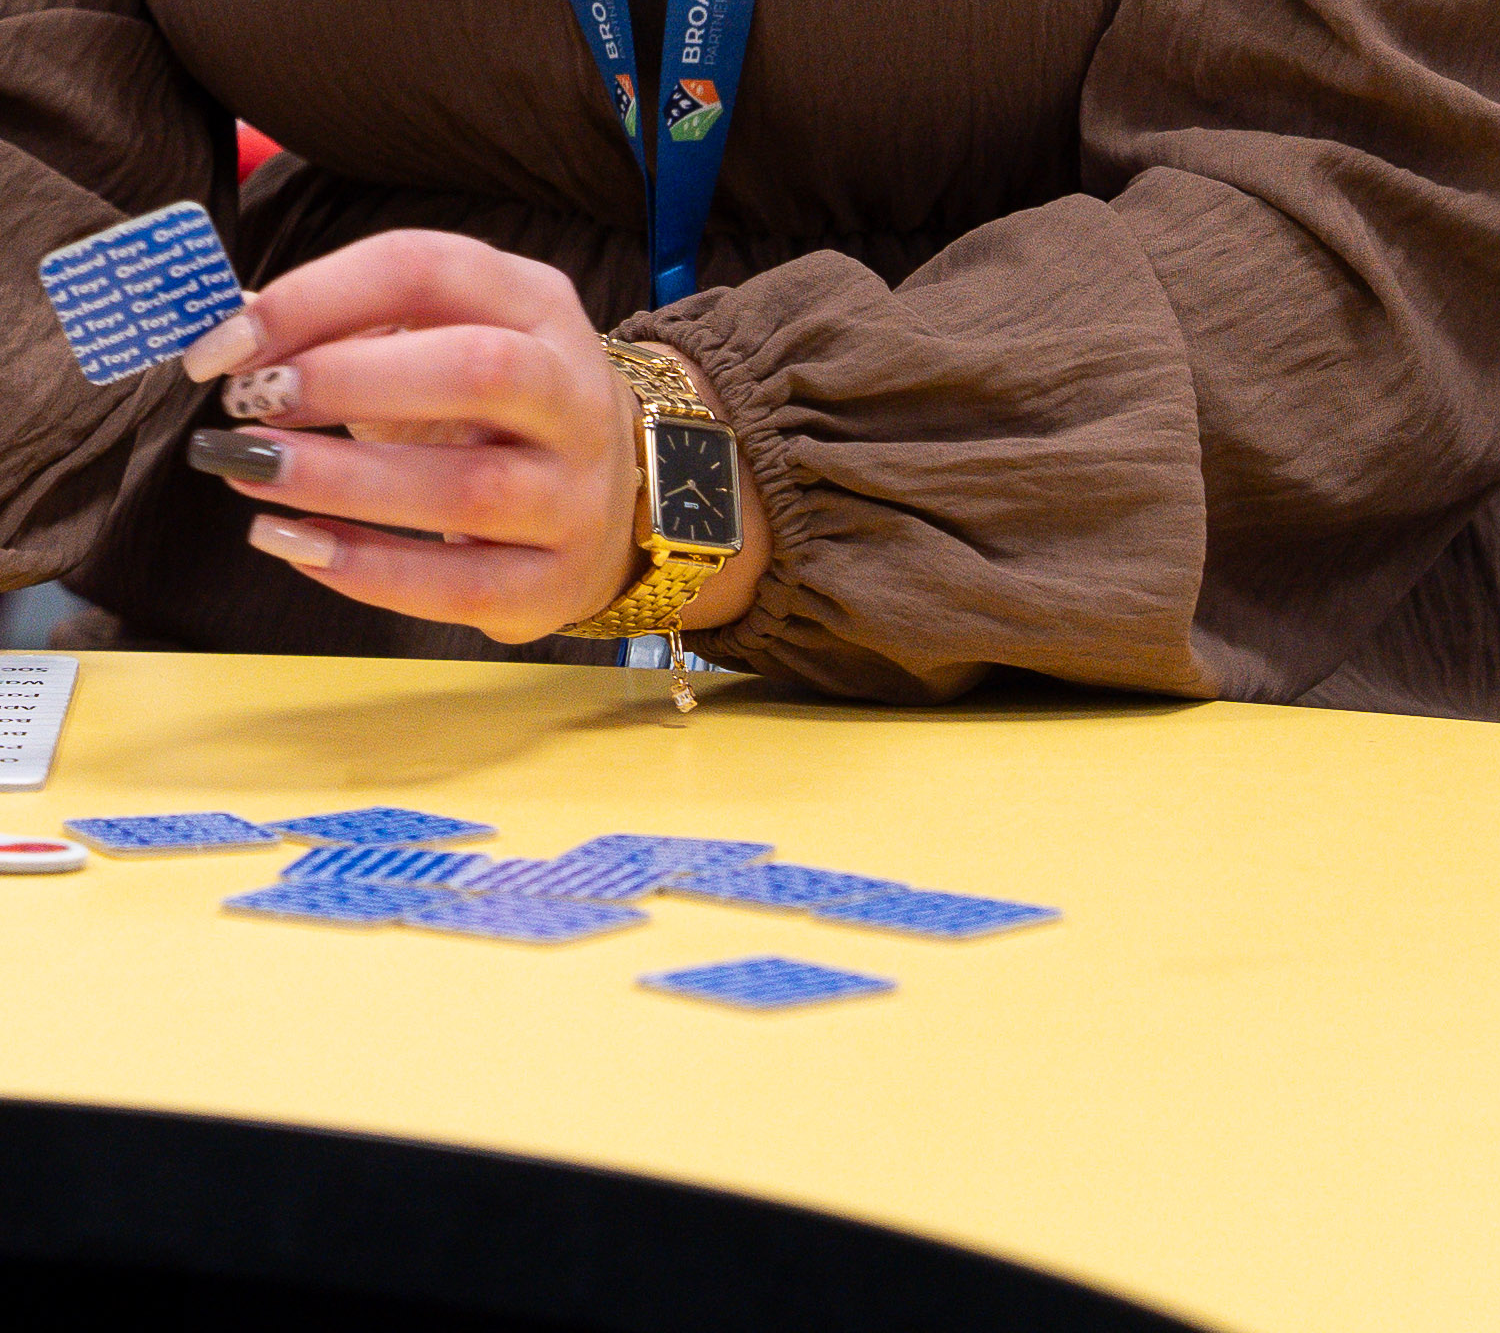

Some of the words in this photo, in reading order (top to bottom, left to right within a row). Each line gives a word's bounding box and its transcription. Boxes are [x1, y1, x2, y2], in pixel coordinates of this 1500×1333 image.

[108, 241, 147, 262] Toys
[70, 277, 108, 295] Toys
[115, 247, 183, 277] Orchard
[124, 277, 163, 297] Toys
[86, 313, 124, 330] Toys
[131, 282, 199, 313] Orchard
[140, 313, 179, 333] Toys
[101, 348, 140, 365] Toys
[146, 317, 214, 348] Orchard
